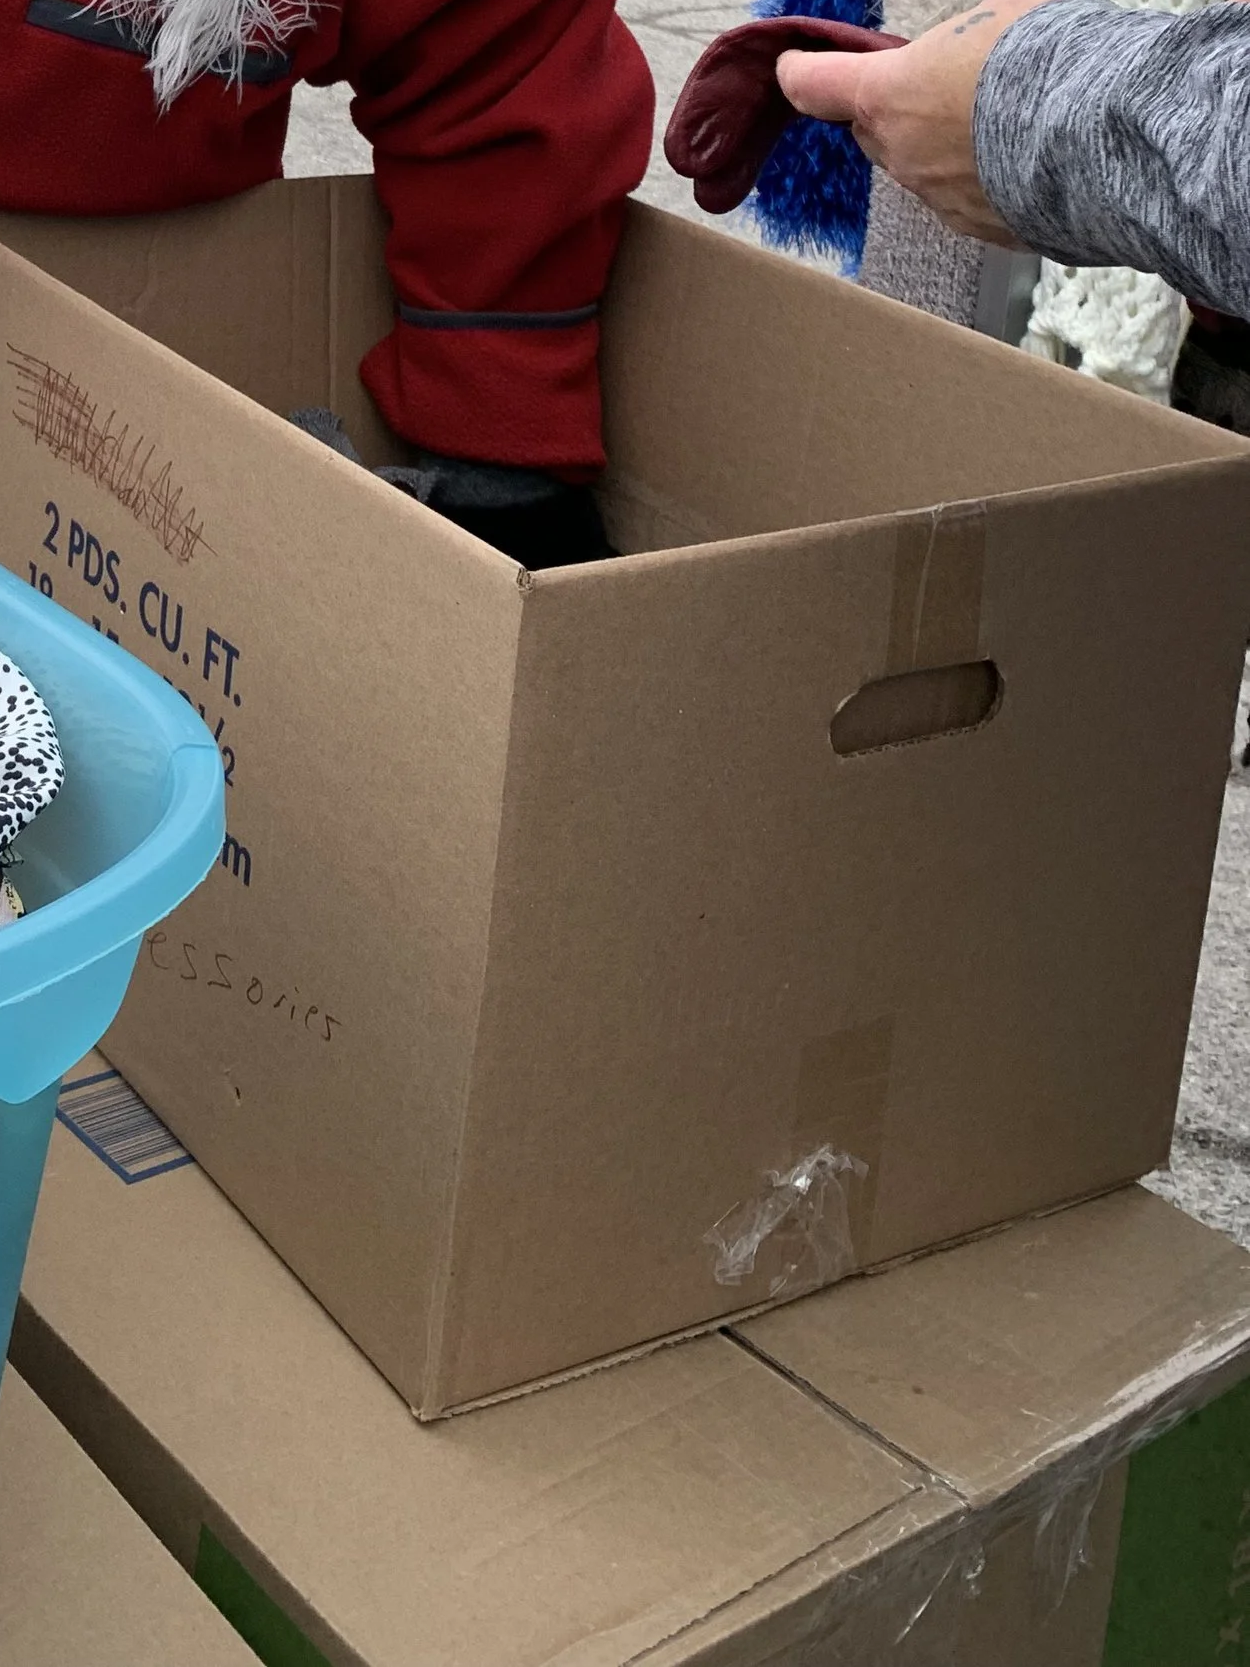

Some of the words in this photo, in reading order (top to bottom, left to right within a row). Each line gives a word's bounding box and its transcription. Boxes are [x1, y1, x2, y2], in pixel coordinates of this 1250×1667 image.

[42, 500, 61, 556] 2
[67, 517, 127, 615] PDS.
[138, 580, 190, 666] CU.
[202, 626, 242, 708] FT.
[146, 930, 343, 1042] essories
